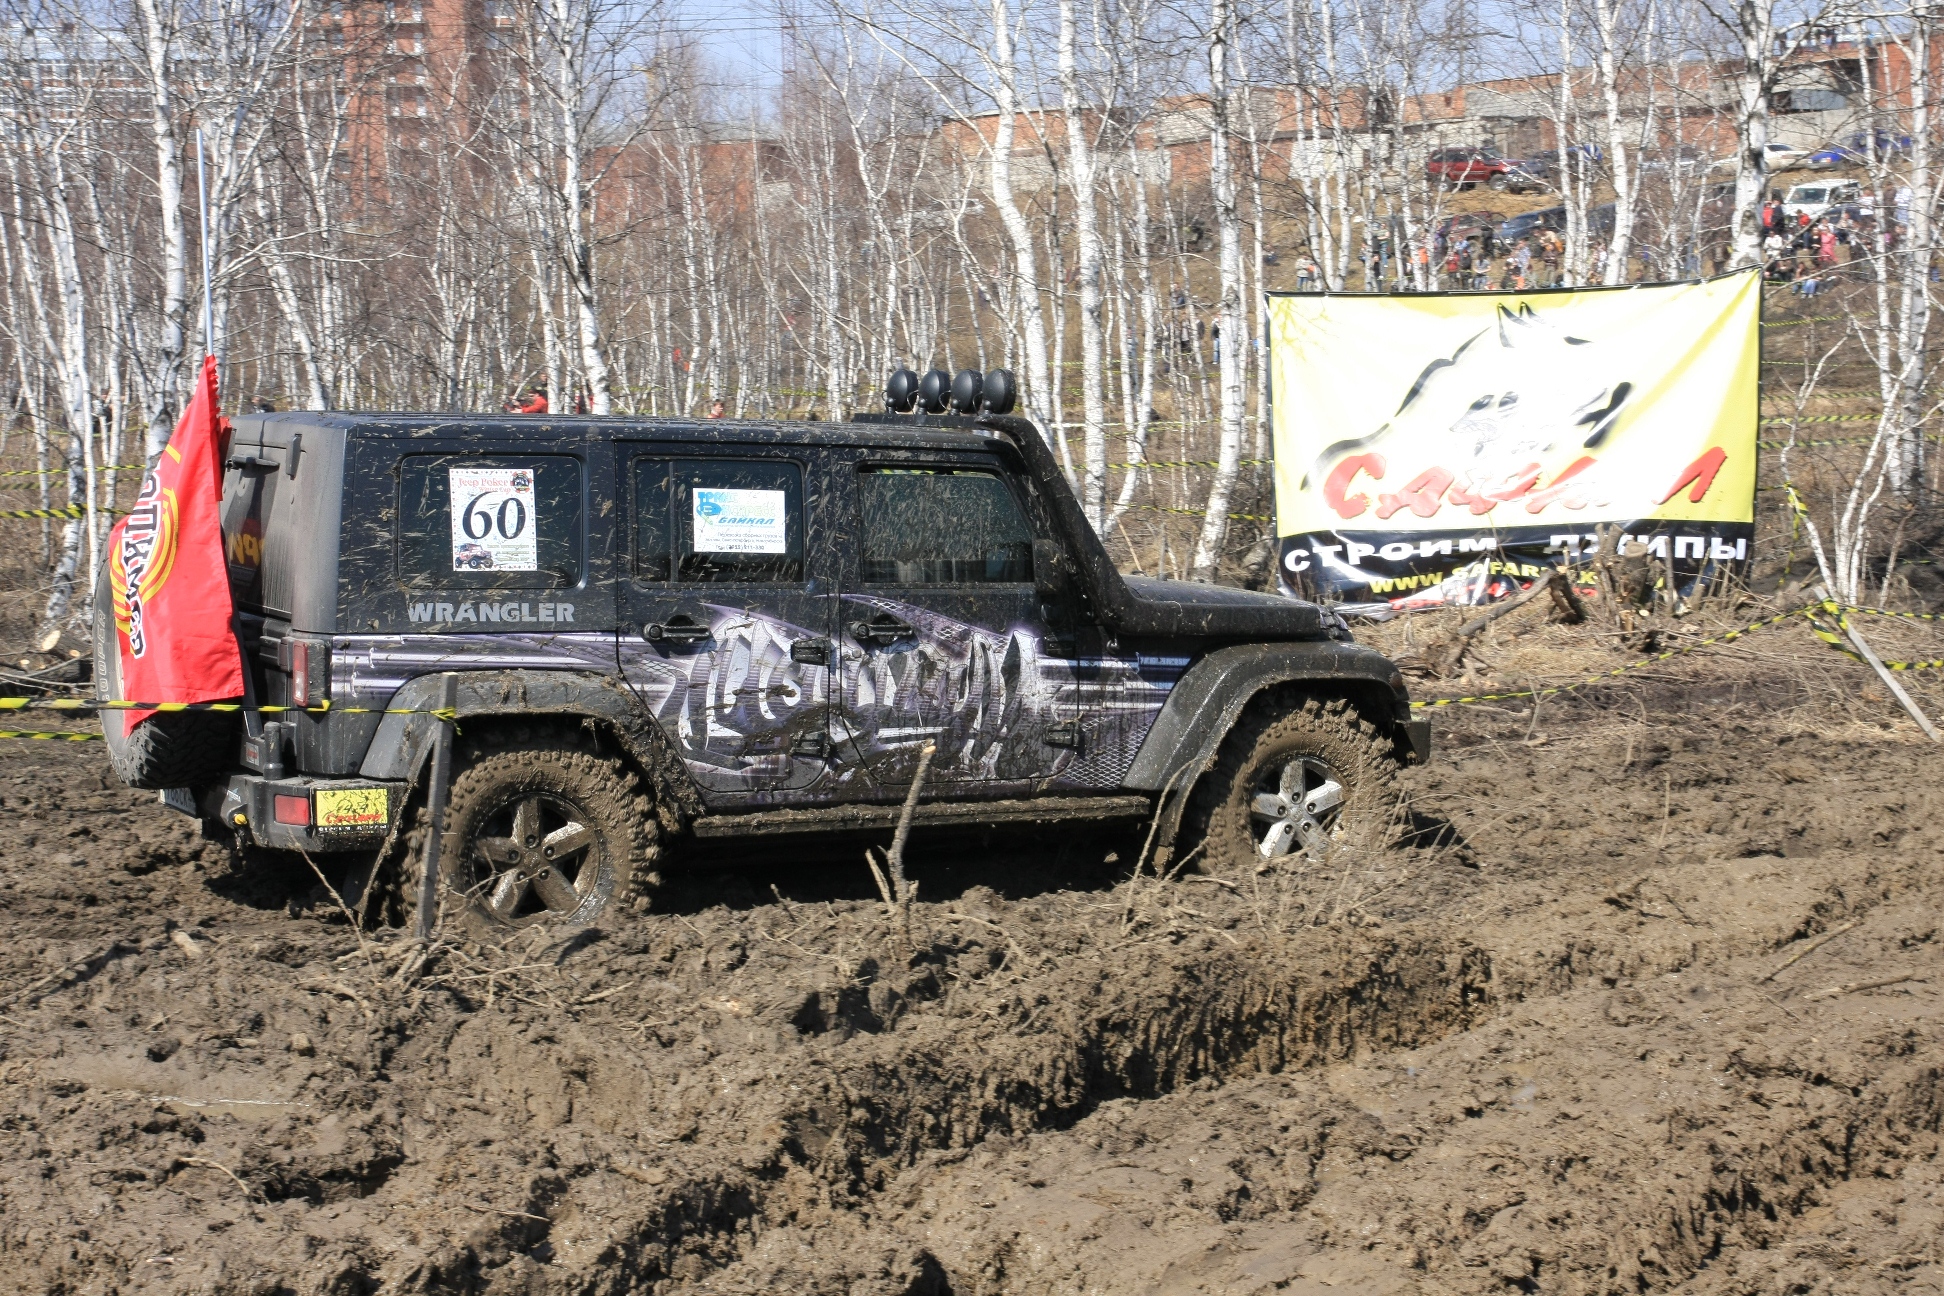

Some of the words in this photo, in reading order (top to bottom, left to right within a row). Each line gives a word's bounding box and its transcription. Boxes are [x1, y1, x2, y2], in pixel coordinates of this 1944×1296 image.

[462, 491, 526, 540] 60
[1285, 537, 1497, 572] СТРОИМ
[408, 602, 575, 622] WRANGLER
